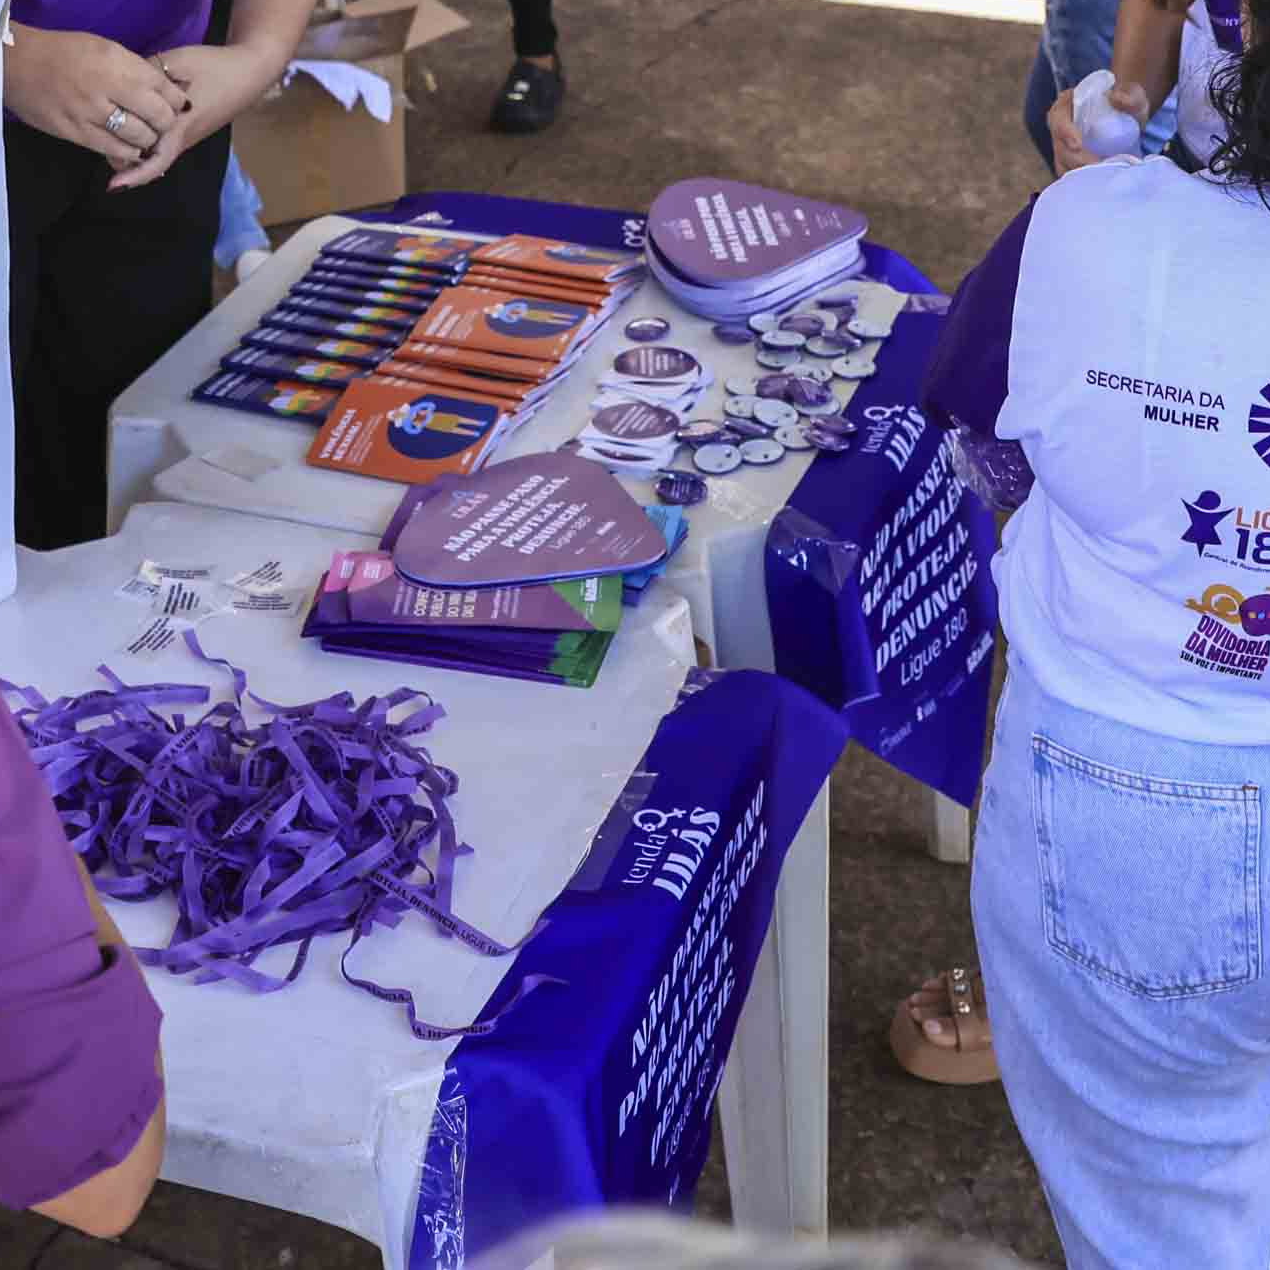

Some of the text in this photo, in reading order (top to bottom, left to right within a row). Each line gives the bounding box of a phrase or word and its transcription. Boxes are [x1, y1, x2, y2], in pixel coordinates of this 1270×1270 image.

[1086, 369, 1226, 411] SECRETARIA DA
[1144, 404, 1219, 432] MULHER
[884, 405, 927, 473] LILÁS
[900, 637, 942, 687] Ligue
[945, 607, 968, 649] 180
[1180, 650, 1263, 681] SUA VOZ É IMPORTANTE
[1184, 631, 1269, 673] DA MULHER
[622, 834, 669, 885] tenda
[652, 806, 721, 901] LILÁS
[632, 973, 669, 1068] NÃO
[618, 1022, 667, 1138] PARA
